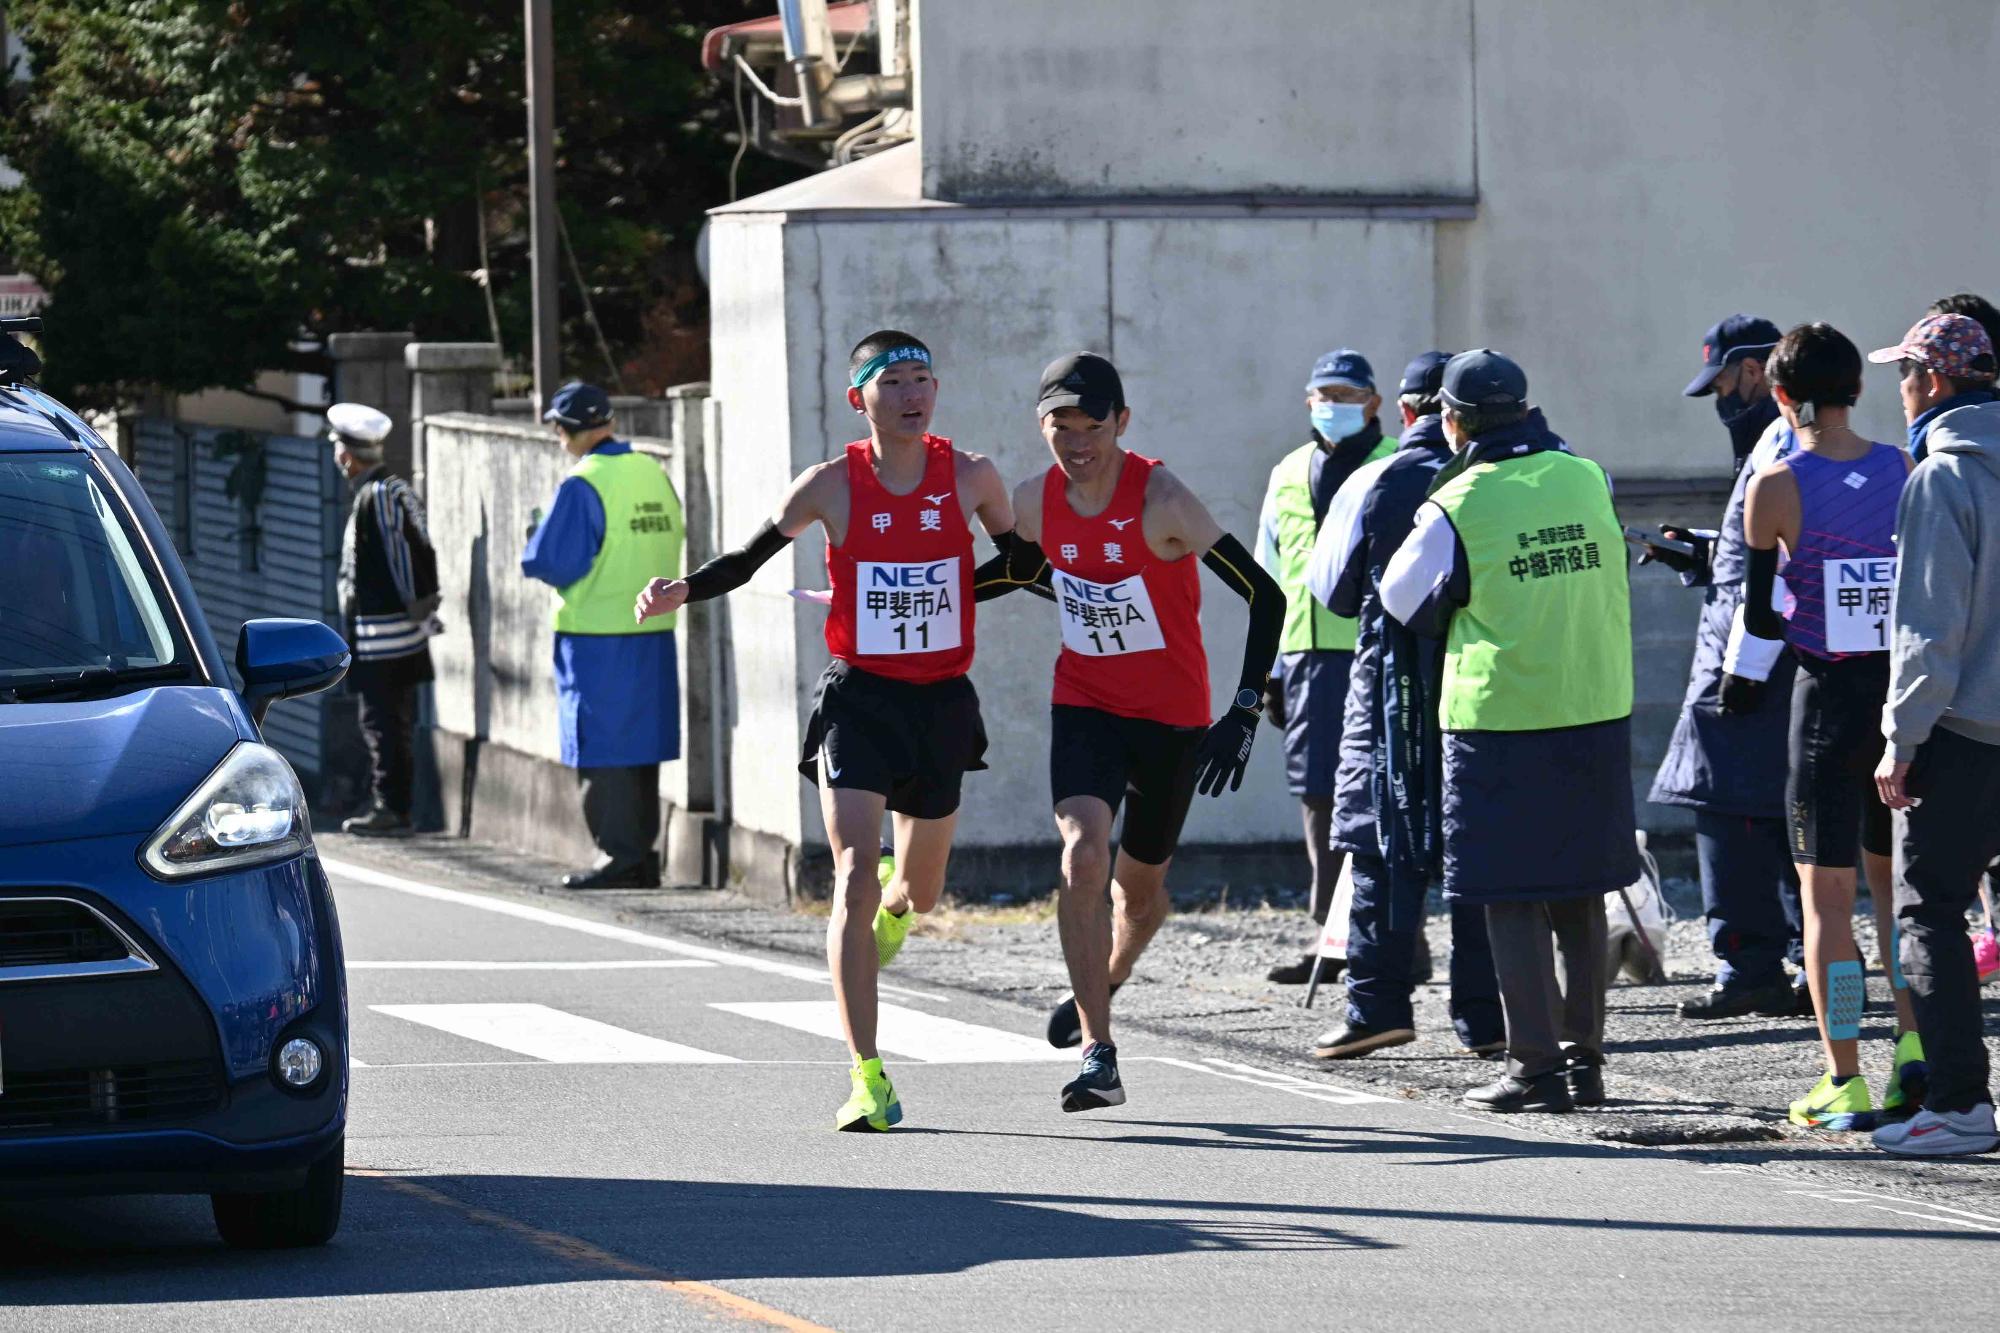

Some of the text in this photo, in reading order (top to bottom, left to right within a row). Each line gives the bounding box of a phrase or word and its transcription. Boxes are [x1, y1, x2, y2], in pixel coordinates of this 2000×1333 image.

[872, 509, 941, 534] 甲斐
[1061, 542, 1125, 565] 甲斐
[1509, 542, 1602, 582] 中継所役員
[872, 563, 948, 587] NEC
[1840, 562, 1897, 583] NE
[866, 587, 952, 620] 甲斐市A
[1062, 576, 1132, 603] NEC
[1838, 586, 1895, 615] 甲府
[1063, 595, 1146, 629] 甲斐市A
[893, 621, 928, 650] 11
[1088, 630, 1126, 654] 11
[1873, 618, 1885, 647] 1
[1391, 772, 1410, 810] NEC
